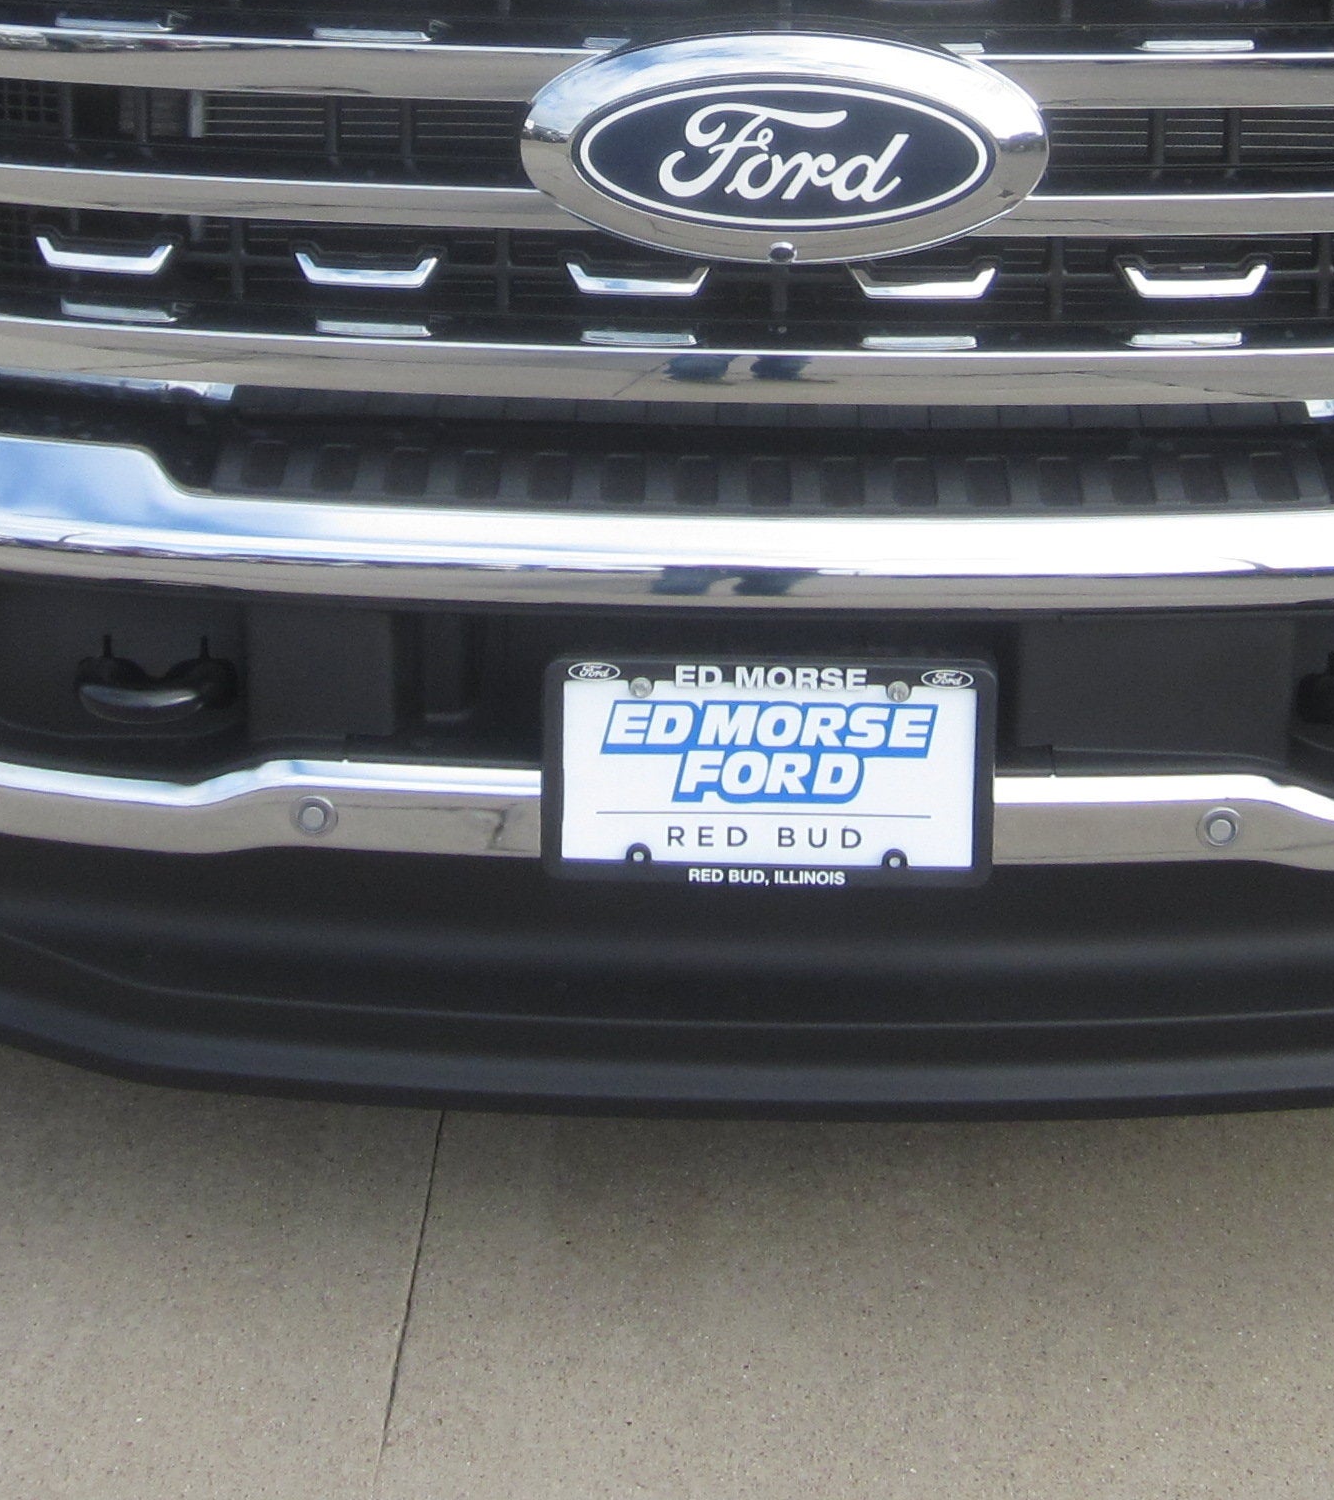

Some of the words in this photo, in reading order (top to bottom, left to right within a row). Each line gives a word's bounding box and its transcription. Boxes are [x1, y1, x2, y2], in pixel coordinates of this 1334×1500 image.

[658, 102, 910, 202] Ford
[579, 665, 611, 678] Ford
[675, 664, 723, 689] ED
[734, 666, 867, 691] MORSE
[933, 672, 964, 686] Ford
[604, 704, 696, 746] ED
[697, 704, 934, 749] MORSE
[678, 750, 861, 796] FORD
[667, 825, 749, 848] RED
[777, 826, 863, 850] BUD
[688, 867, 725, 884] RED
[728, 869, 770, 886] BUD,
[774, 870, 846, 886] ILLINOIS
